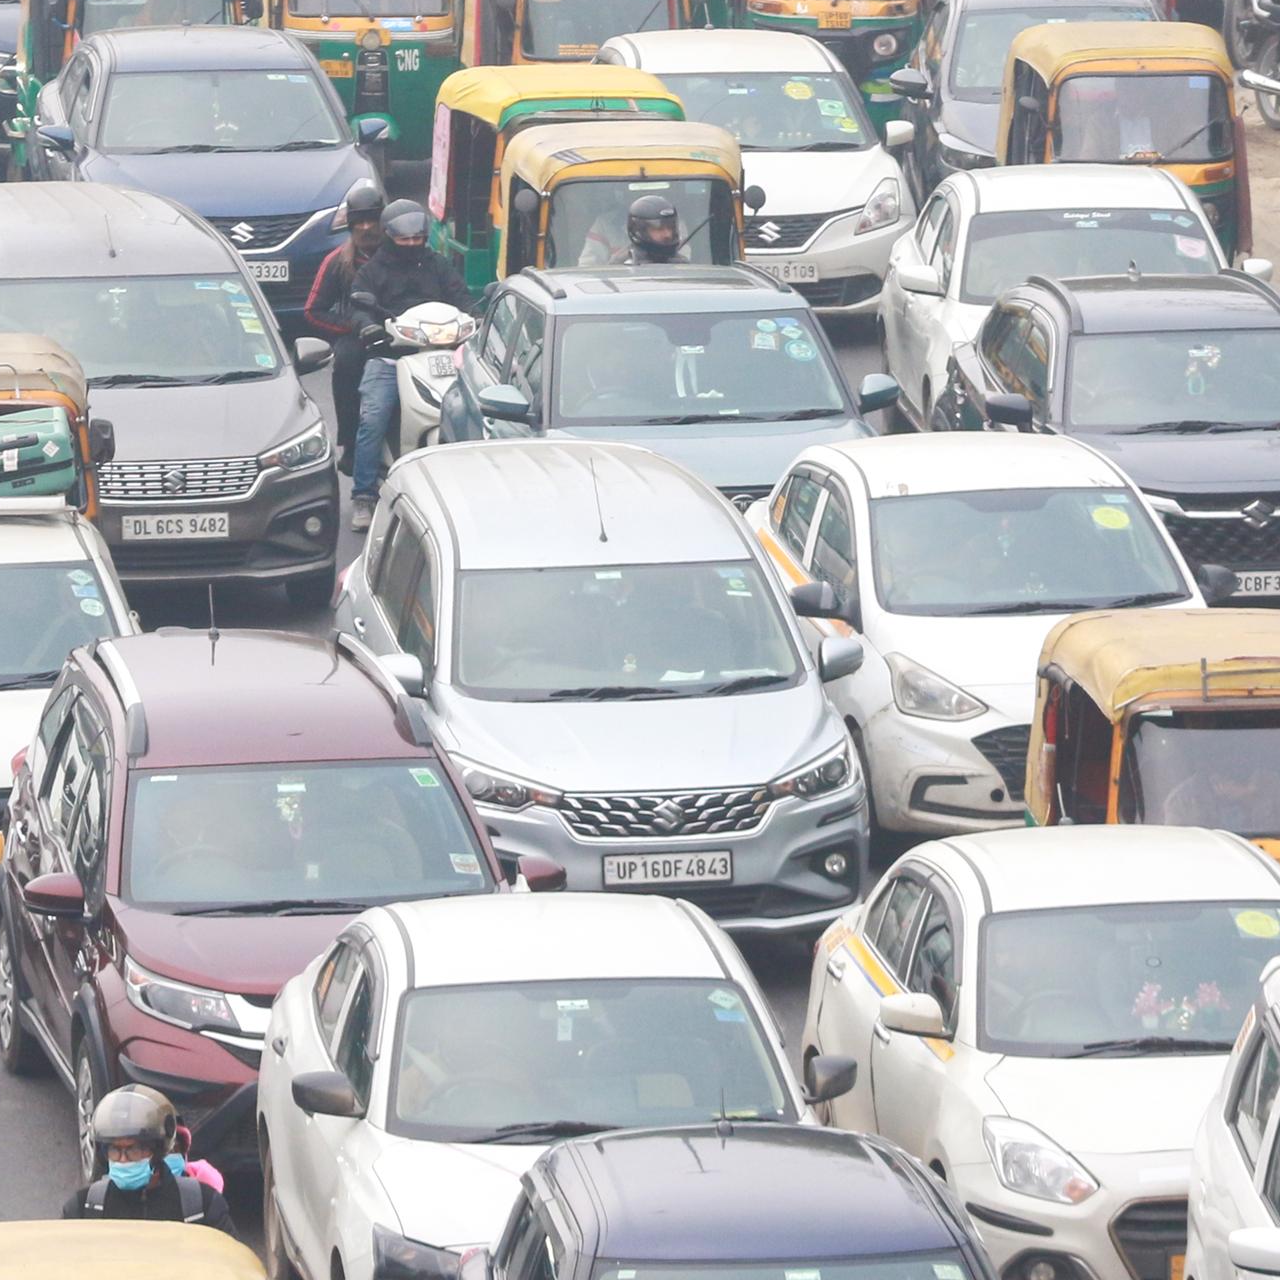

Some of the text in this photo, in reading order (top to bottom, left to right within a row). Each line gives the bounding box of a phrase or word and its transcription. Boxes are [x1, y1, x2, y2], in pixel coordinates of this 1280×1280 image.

[396, 49, 419, 71] CNG
[133, 517, 226, 535] DL 6CS 9482
